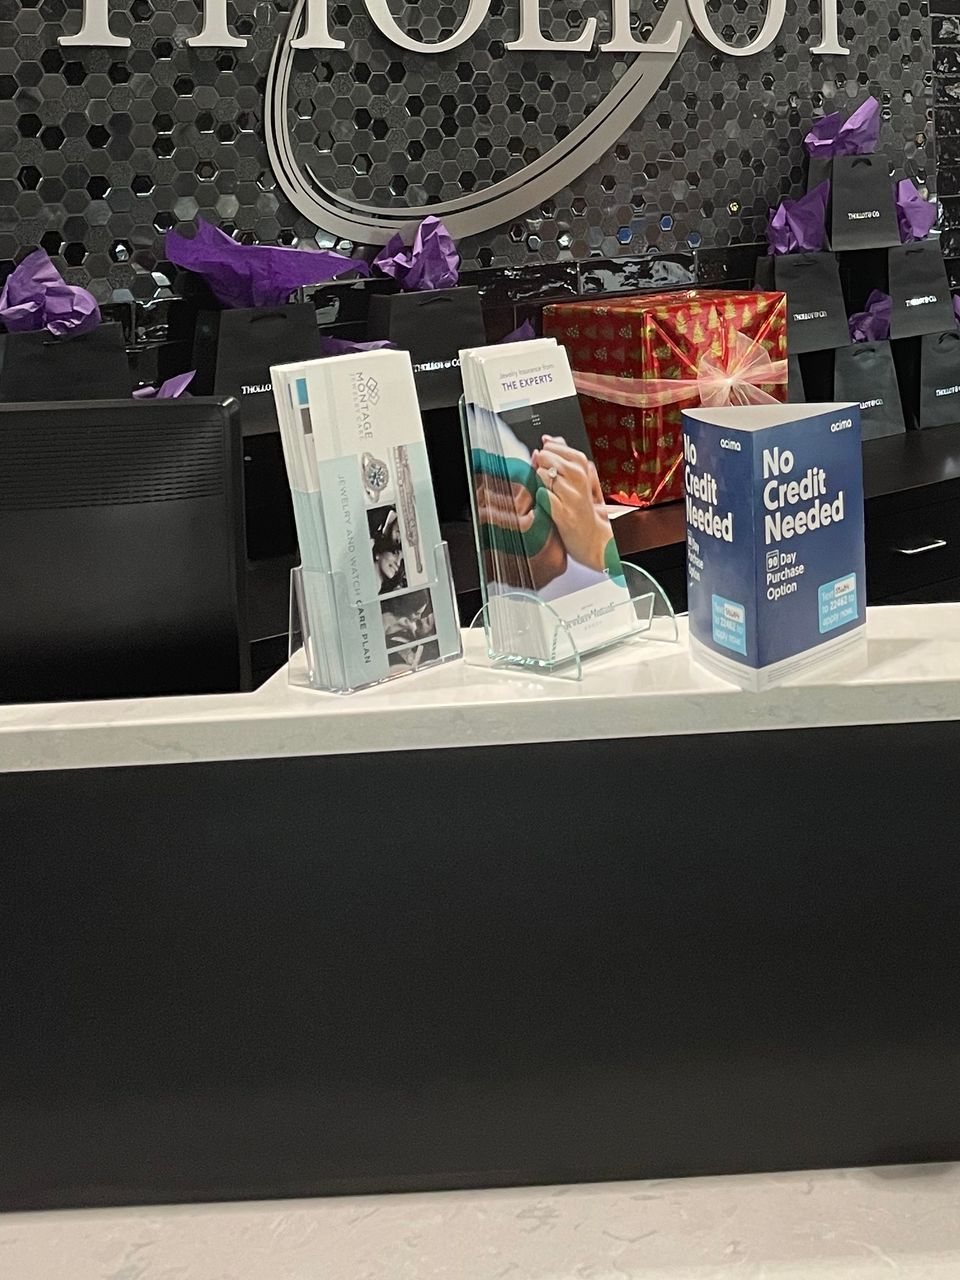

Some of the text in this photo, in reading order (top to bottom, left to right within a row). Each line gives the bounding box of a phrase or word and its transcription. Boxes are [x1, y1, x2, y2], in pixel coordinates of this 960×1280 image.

[241, 383, 272, 395] THOLLO
[501, 373, 553, 391] THE EXPERTS
[356, 371, 374, 439] MONTAGE
[830, 418, 852, 433] acima
[683, 433, 697, 466] No
[720, 438, 741, 451] acima
[762, 446, 794, 479] No
[684, 465, 718, 506] Credit
[763, 467, 826, 511] Credit
[685, 494, 734, 543] Needed
[764, 491, 844, 545] Needed
[337, 475, 371, 664] JEWELRY AND WATCH CARE PLAN
[766, 564, 805, 586] Purchase
[767, 551, 797, 568] 90 Day
[766, 582, 798, 601] Option
